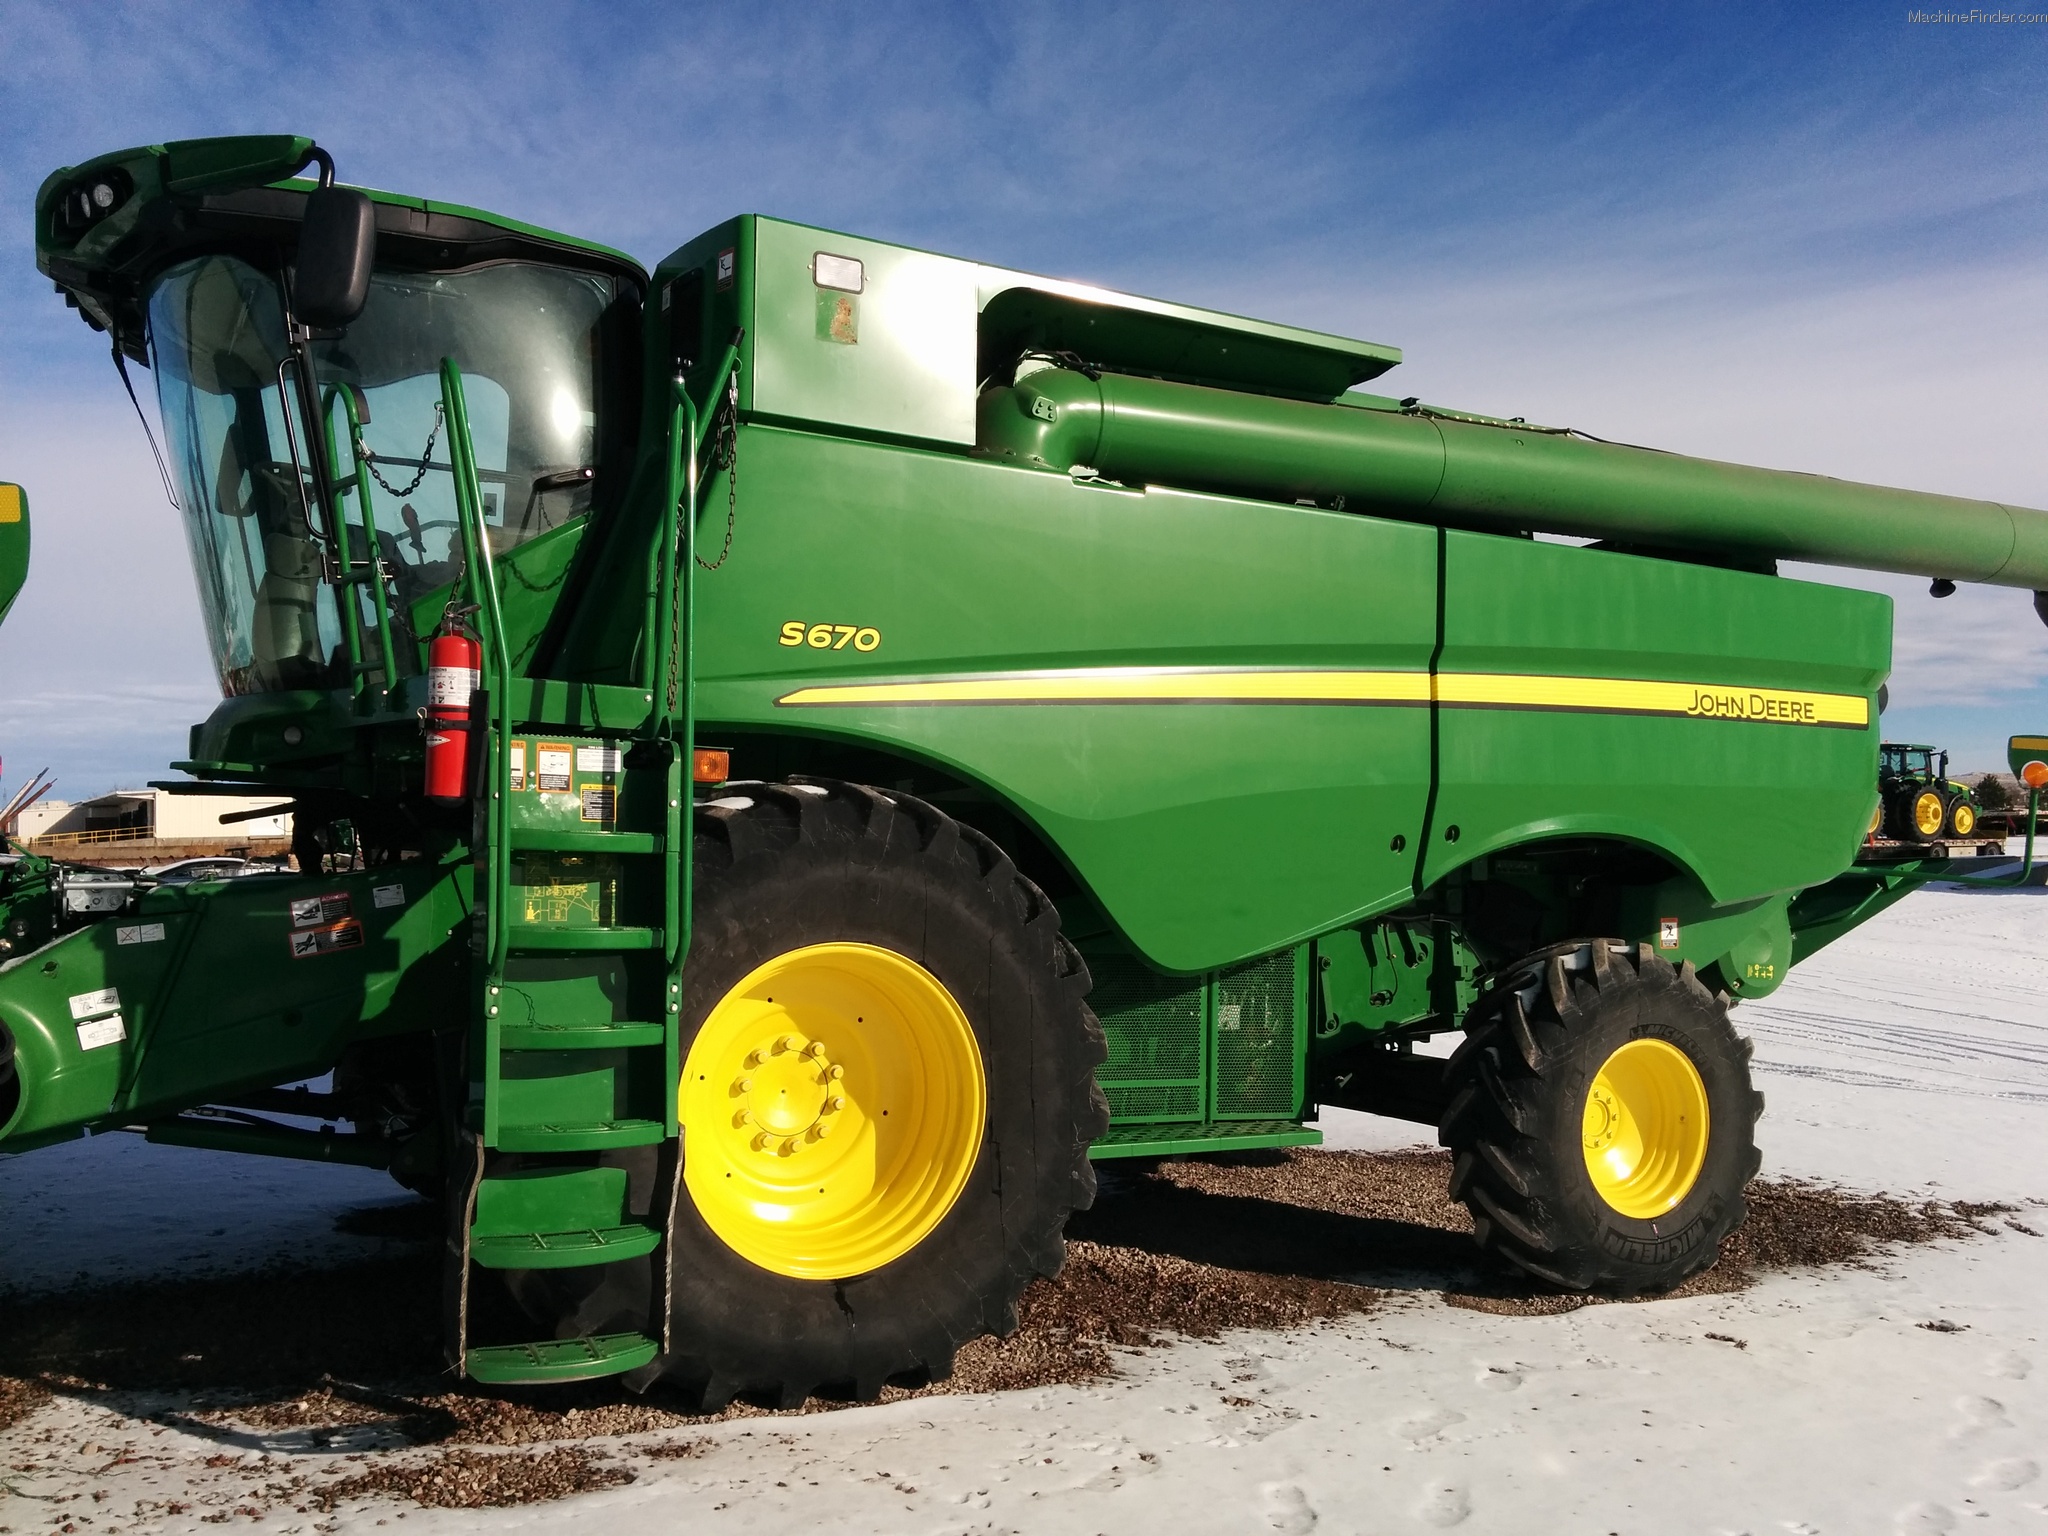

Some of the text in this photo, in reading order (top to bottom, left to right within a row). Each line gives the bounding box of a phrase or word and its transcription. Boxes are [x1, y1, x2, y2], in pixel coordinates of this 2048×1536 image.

[778, 620, 882, 652] S670
[1688, 690, 1815, 720] JOHN DEERE
[1602, 1220, 1707, 1264] MICHELIN
